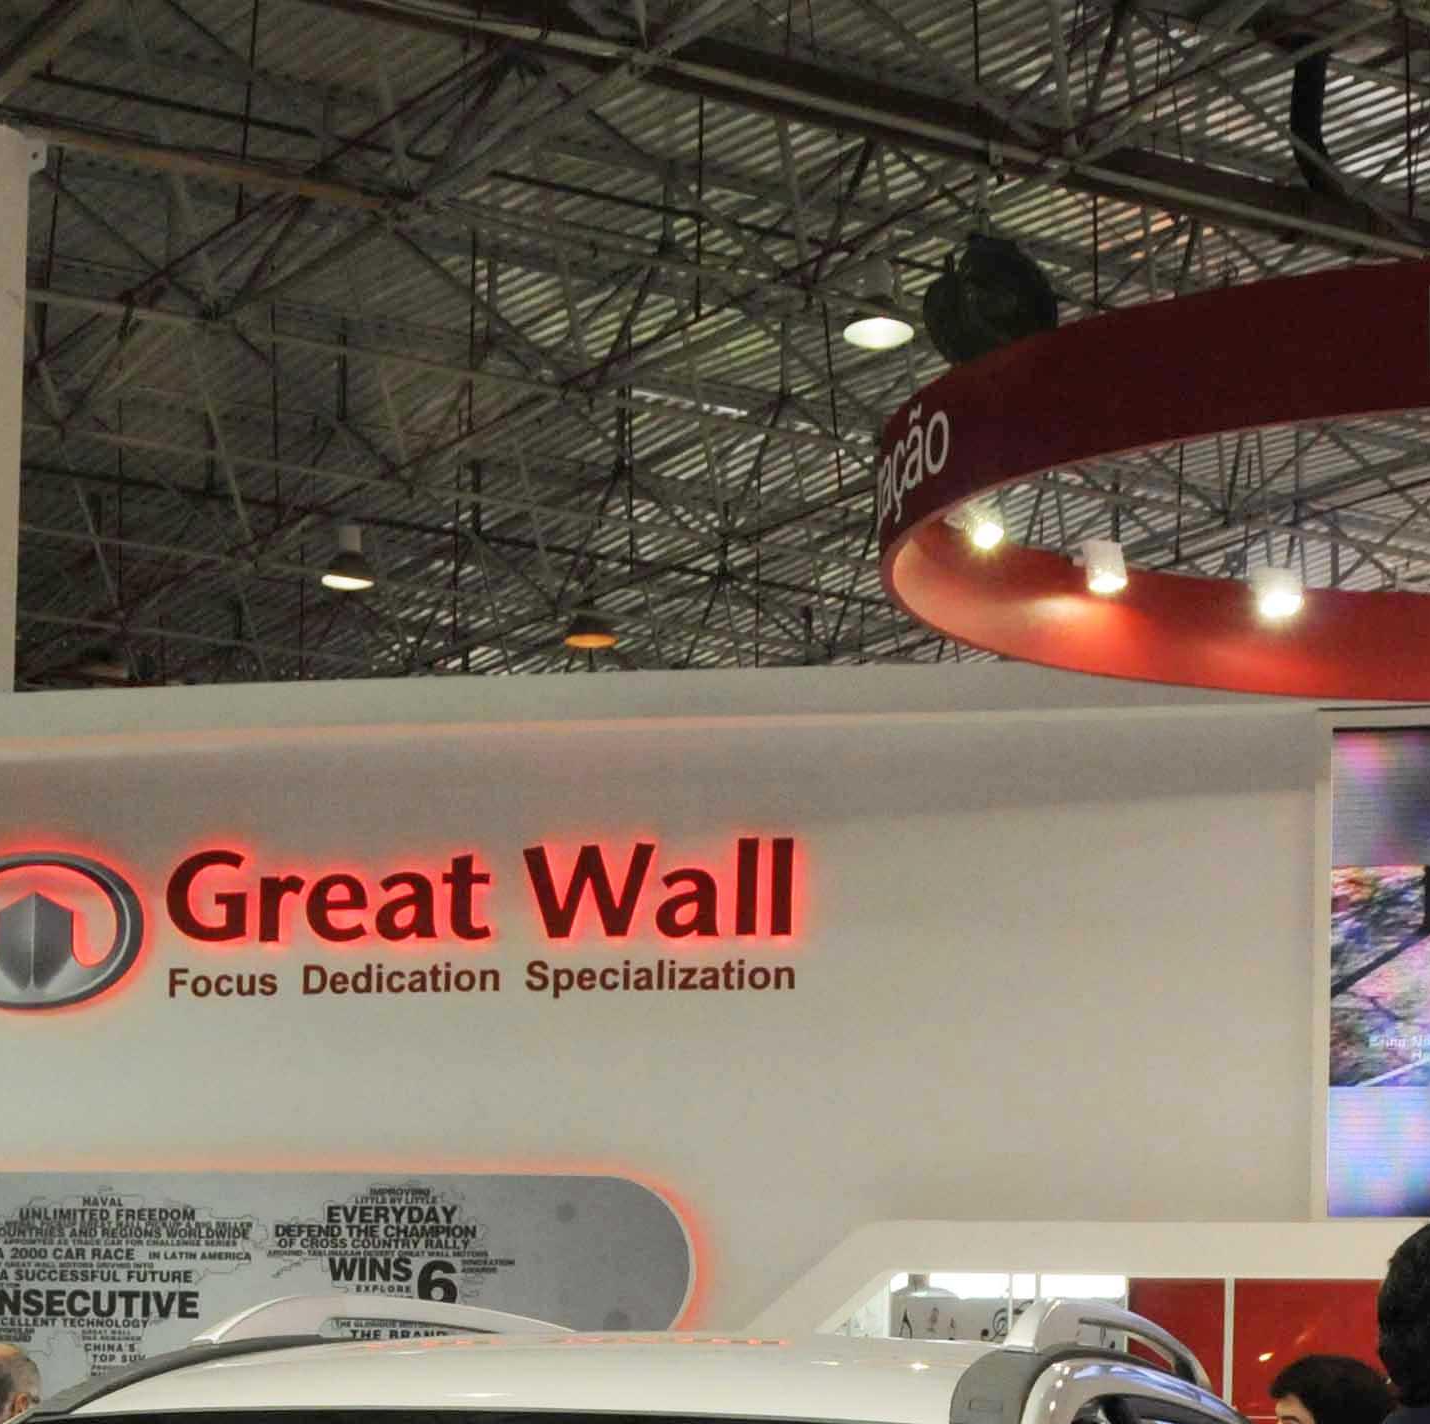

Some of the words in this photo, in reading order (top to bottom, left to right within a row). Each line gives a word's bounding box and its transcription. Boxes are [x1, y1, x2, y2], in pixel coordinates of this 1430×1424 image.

[877, 402, 950, 538] ação
[166, 850, 491, 943] Great
[523, 837, 794, 940] Wall
[168, 966, 278, 999] Focus
[302, 963, 501, 996] Dedication
[525, 960, 797, 998] Specialization
[19, 1208, 110, 1221] UNLIMITED
[116, 1208, 196, 1222] FREEDOM
[327, 1205, 458, 1224] EVERYDAY
[102, 1228, 162, 1239] REGIONS
[166, 1228, 251, 1241] WORLDWIDE
[274, 1224, 342, 1238] DEFEND
[346, 1224, 379, 1238] THE
[383, 1224, 477, 1239] CHAMPION
[278, 1238, 294, 1249] OF
[300, 1238, 347, 1249] CROSS
[351, 1238, 420, 1250] COUNTRY
[424, 1238, 470, 1250] RALLY
[10, 1247, 48, 1260] 2000
[53, 1248, 87, 1260] CAR
[91, 1248, 135, 1260] RACE
[148, 1251, 161, 1261] IN
[163, 1251, 197, 1261] LATIN
[201, 1251, 252, 1262] AMERICA
[14, 1269, 121, 1283] SUCCESSFUL
[126, 1270, 193, 1284] FUTURE
[328, 1257, 413, 1282] WINS
[417, 1259, 459, 1303] 6
[62, 1318, 149, 1329] TECHNOLOGY
[91, 1354, 116, 1363] TOP
